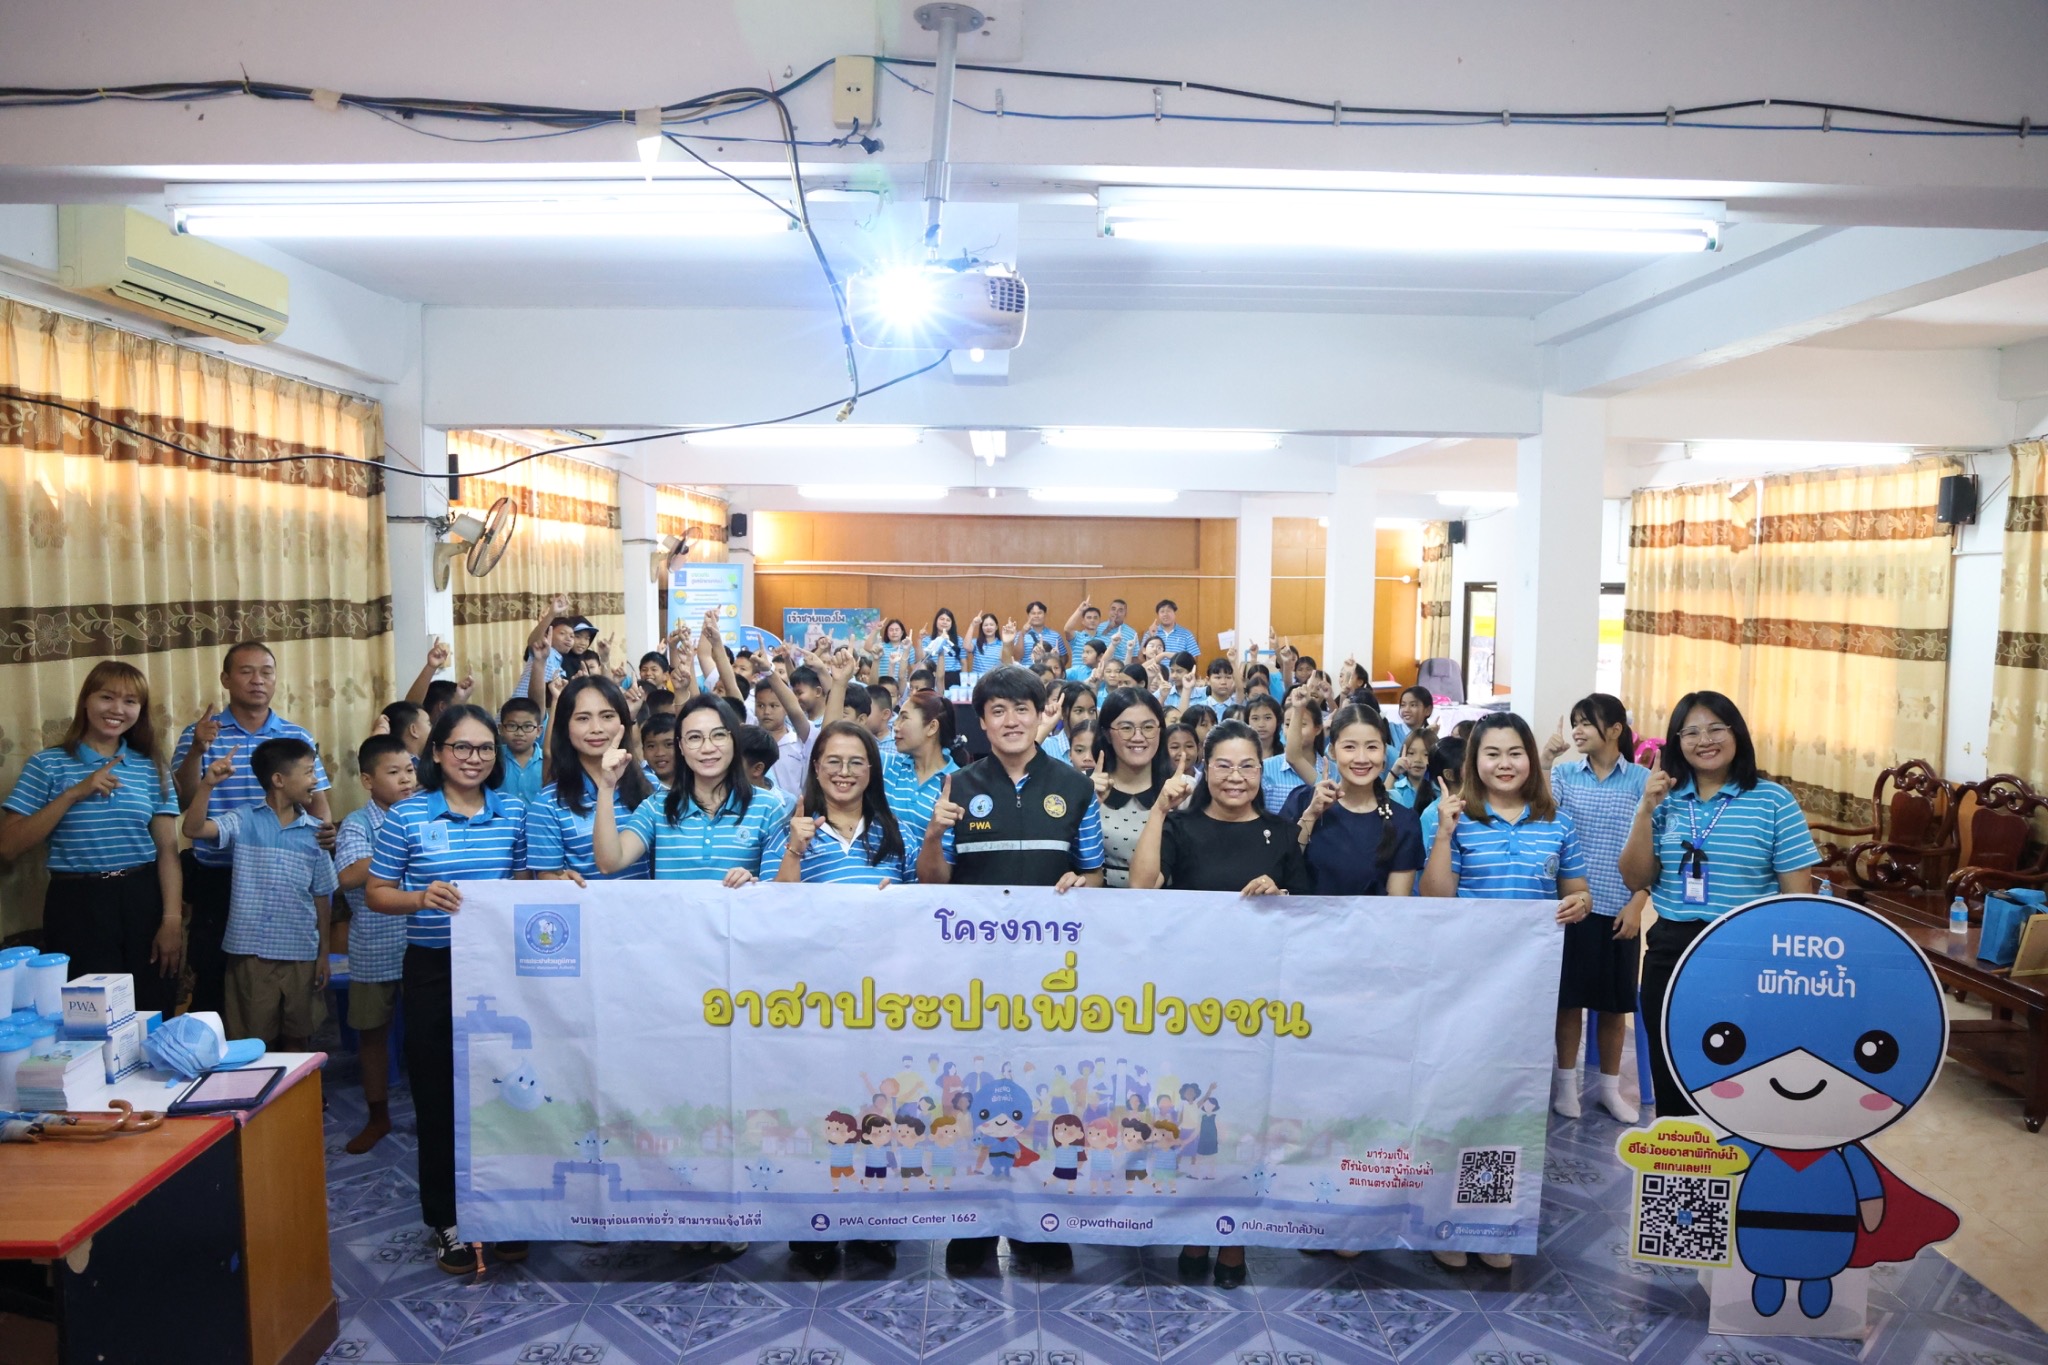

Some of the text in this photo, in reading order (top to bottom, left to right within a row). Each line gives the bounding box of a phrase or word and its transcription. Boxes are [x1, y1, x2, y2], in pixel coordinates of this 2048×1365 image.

[969, 821, 992, 831] PWA
[934, 908, 1083, 942] โครงการ
[1772, 933, 1845, 959] HERO
[1757, 964, 1856, 998] พิทักษ์น้ำ
[702, 951, 1312, 1038] อาสาประปาเพื่อปวงชน
[69, 1001, 97, 1012] PWA
[1657, 1130, 1710, 1144] มาร่วมเป็น
[1366, 1148, 1409, 1160] มาร่วมเป็น
[1340, 1159, 1434, 1176] ฮีโร่น้อยอาสาพิทักษ์น้ำ
[1653, 1162, 1712, 1174] สแกนเลย!!!
[570, 1209, 762, 1230] พบเหตุท่อแตกท่อรั่ว สามารถแจ้งได้ที่
[839, 1213, 977, 1226] PWA Contact Center 1662
[1066, 1216, 1153, 1230] @pwathailand
[1241, 1219, 1325, 1235] กปภ.สาขาใกล้บ้าน
